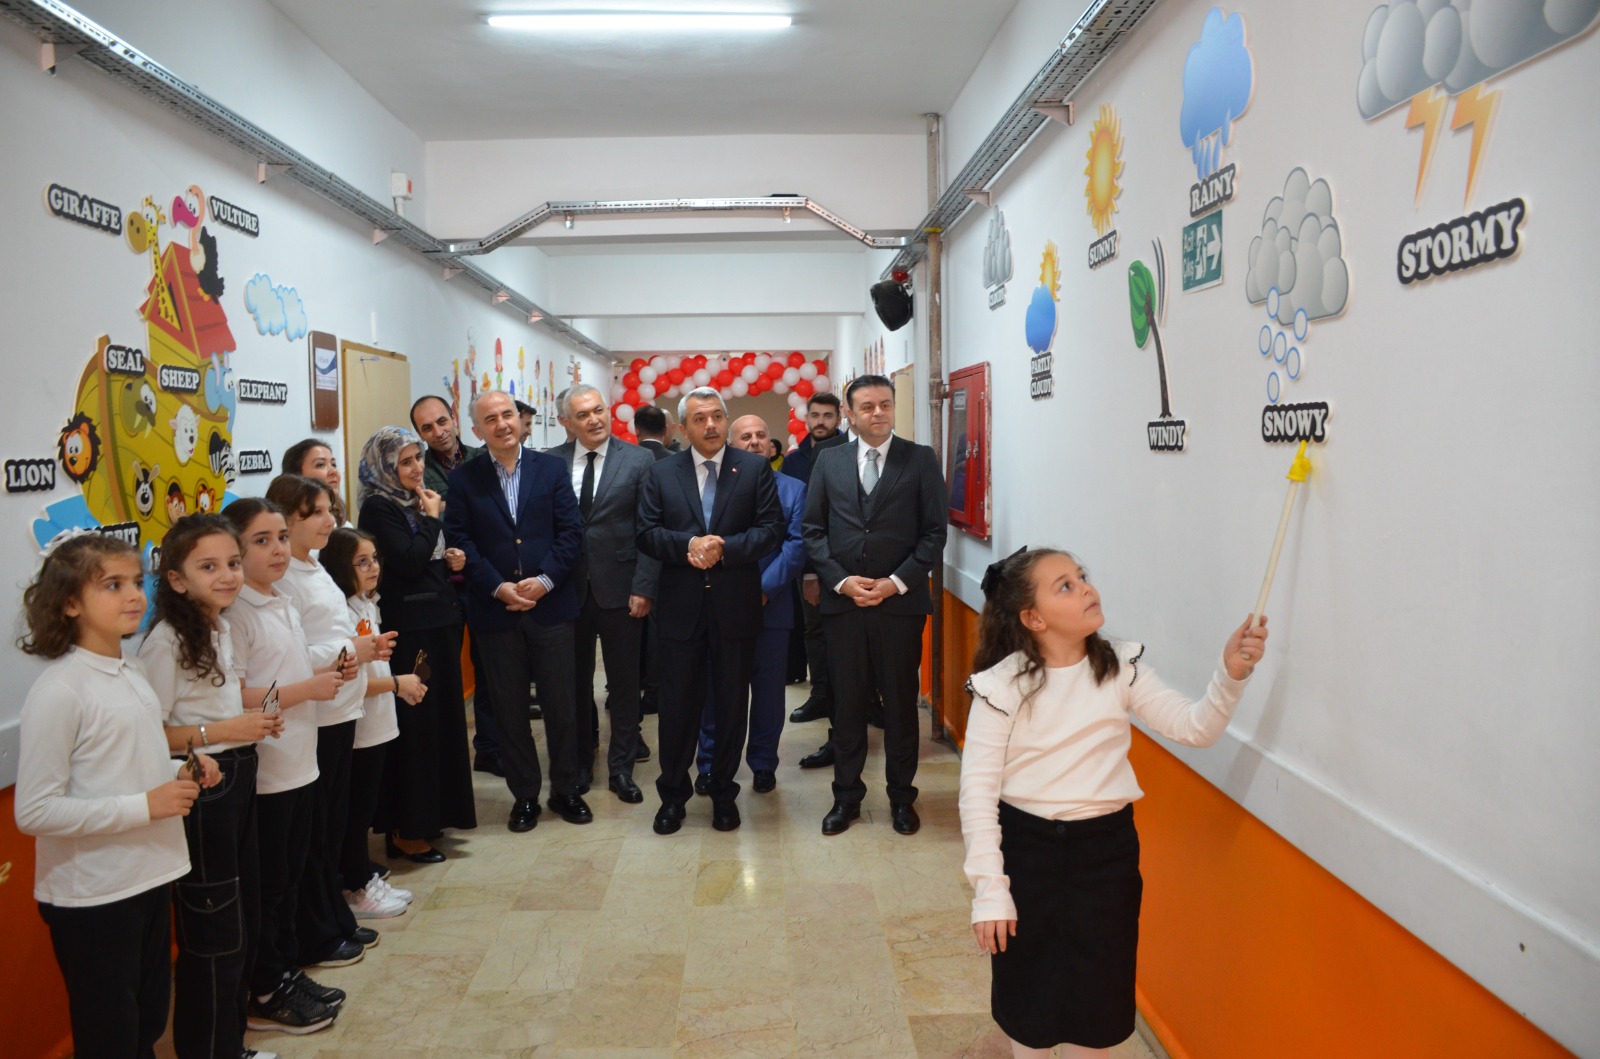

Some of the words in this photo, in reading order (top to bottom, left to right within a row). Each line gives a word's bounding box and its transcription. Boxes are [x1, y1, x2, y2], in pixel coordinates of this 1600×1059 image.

[1191, 169, 1235, 212] RAINY
[50, 188, 121, 231] GIRAFFE
[211, 199, 259, 232] VULTURE
[1089, 234, 1117, 266] SUNNY
[1401, 206, 1521, 278] STORMY
[108, 349, 145, 372] SEAL
[161, 368, 200, 390] SHEEP
[239, 381, 287, 401] ELEPHANT
[1031, 378, 1051, 397] CLOUDY
[1263, 408, 1326, 437] SNOWY
[1148, 425, 1185, 447] WINDY
[239, 455, 272, 470] ZEBRA
[8, 464, 54, 488] LION
